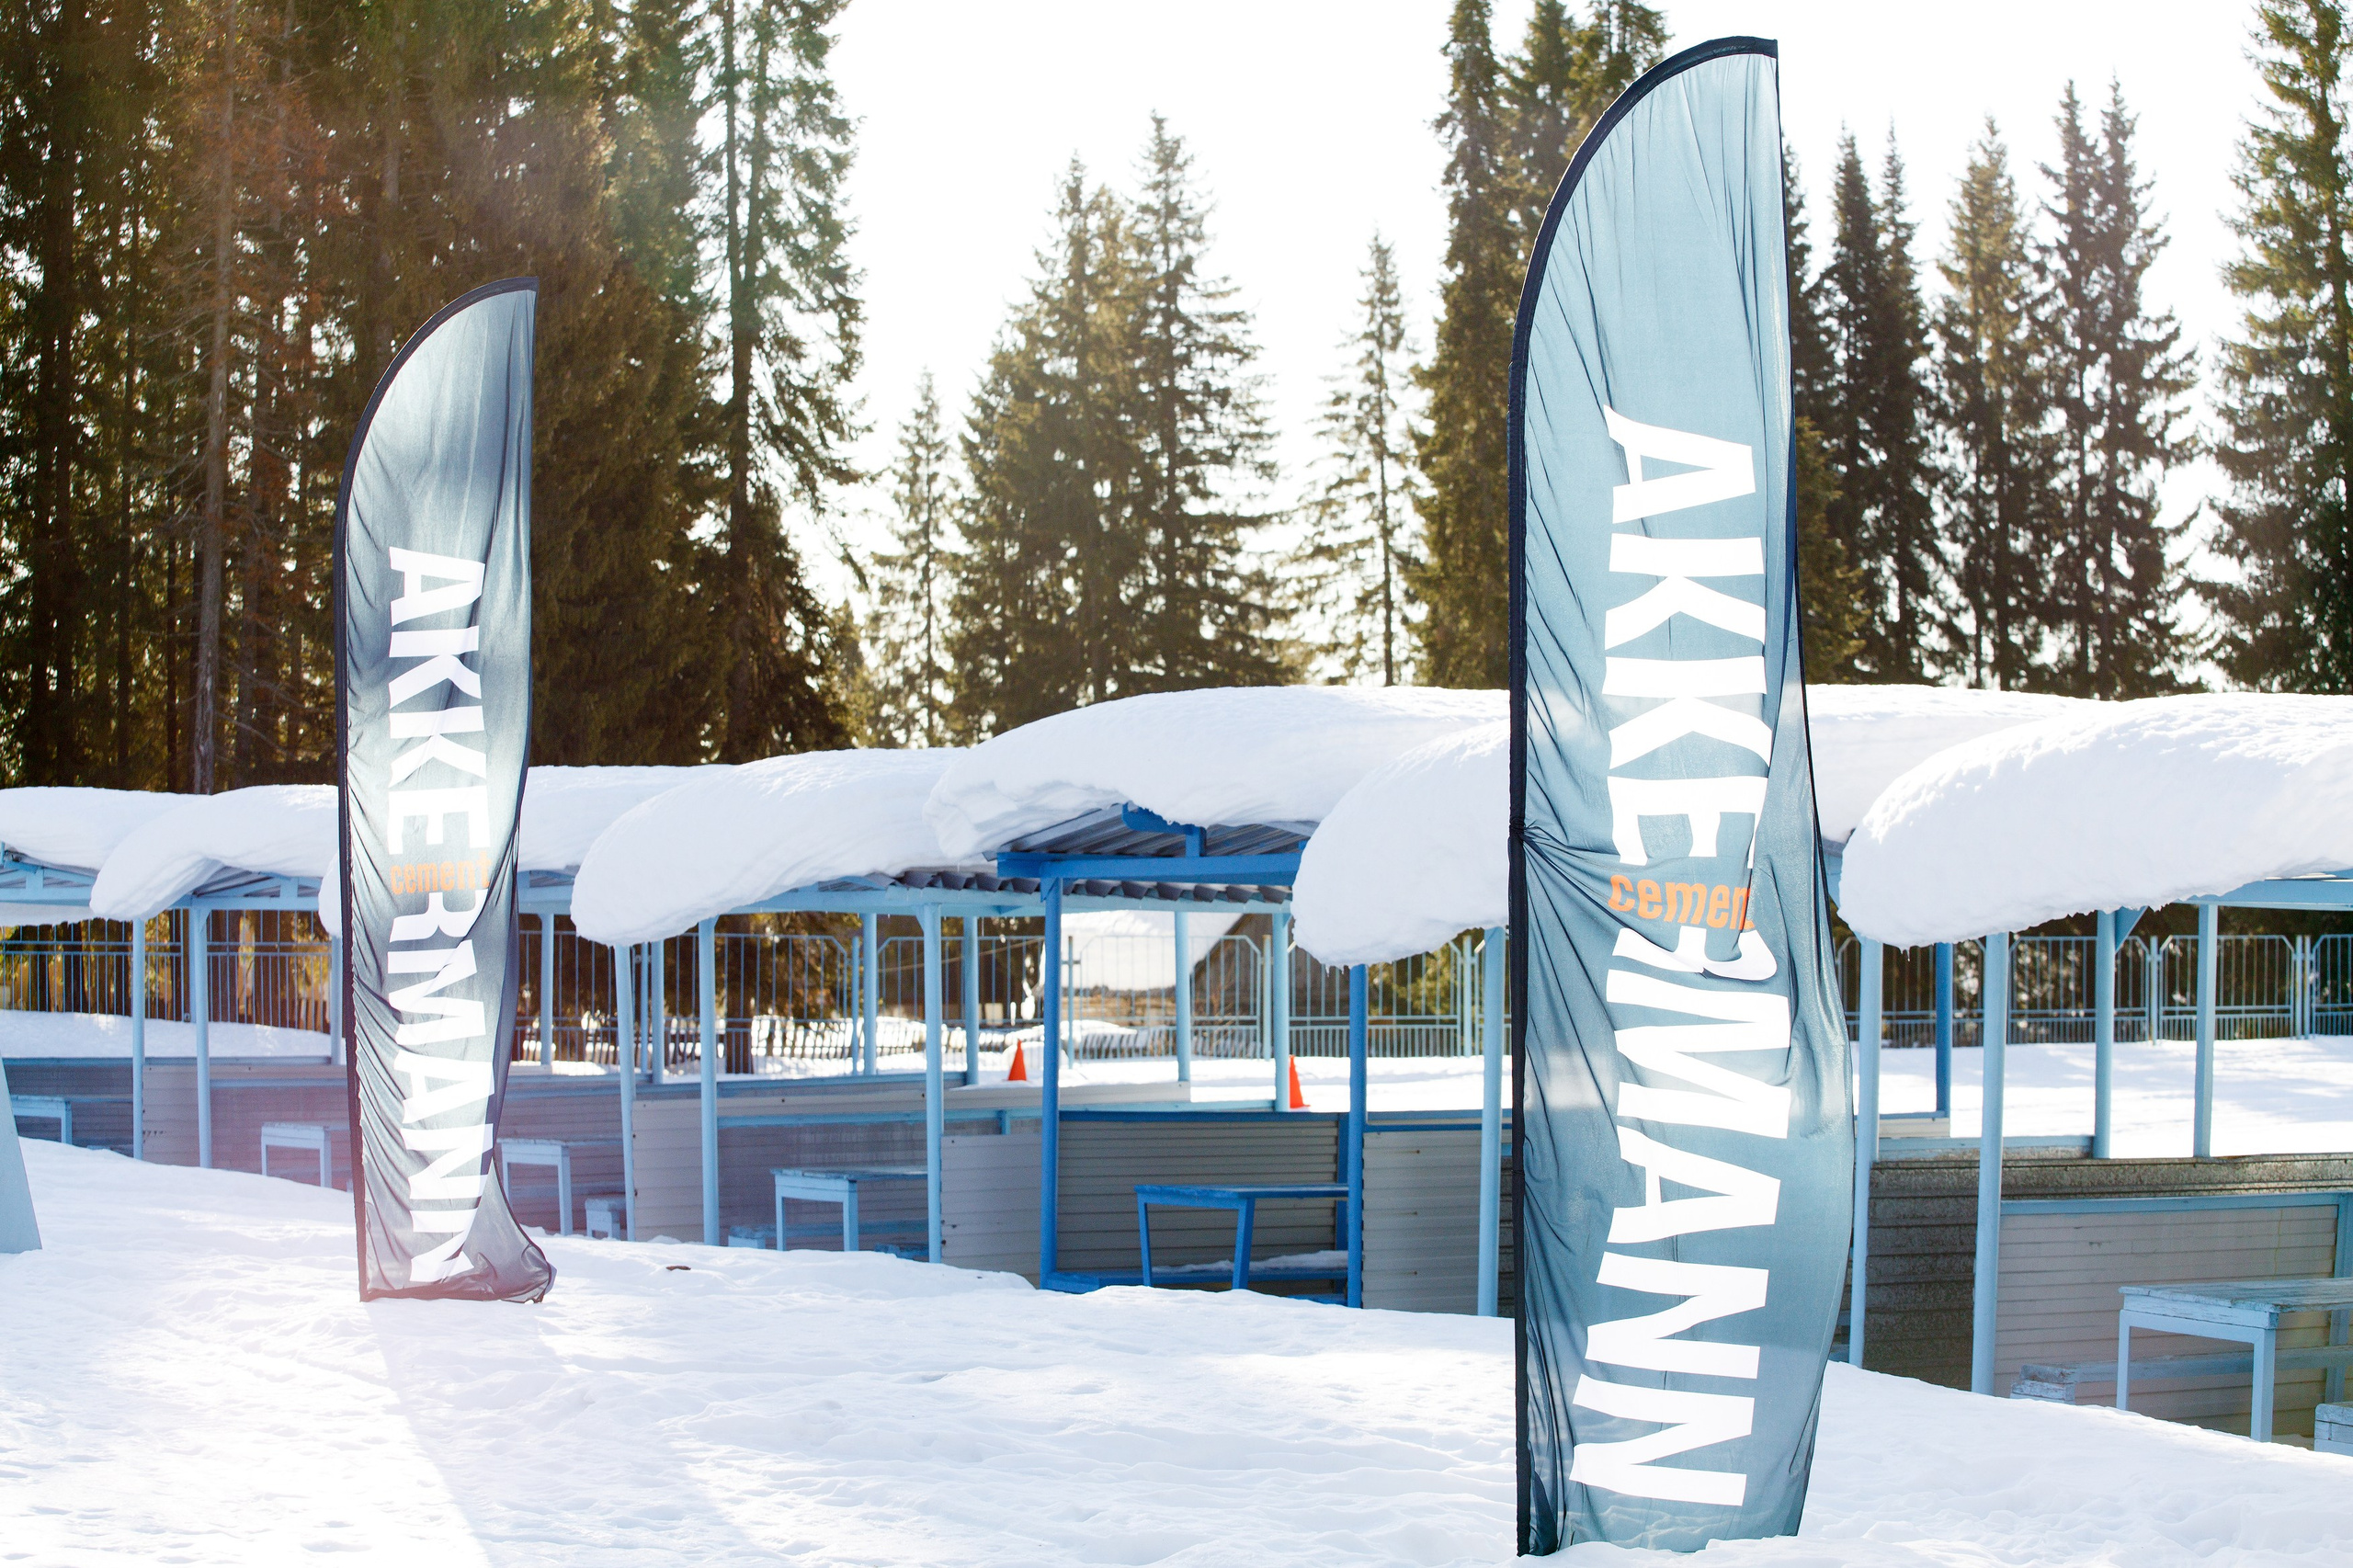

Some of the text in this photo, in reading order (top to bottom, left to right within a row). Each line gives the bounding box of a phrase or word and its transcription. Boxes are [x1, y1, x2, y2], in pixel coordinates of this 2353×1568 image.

[388, 546, 495, 1282] AKKERMANN
[391, 850, 492, 895] cement
[1569, 404, 1791, 1506] AKKERMANN
[1608, 874, 1755, 930] cemen
